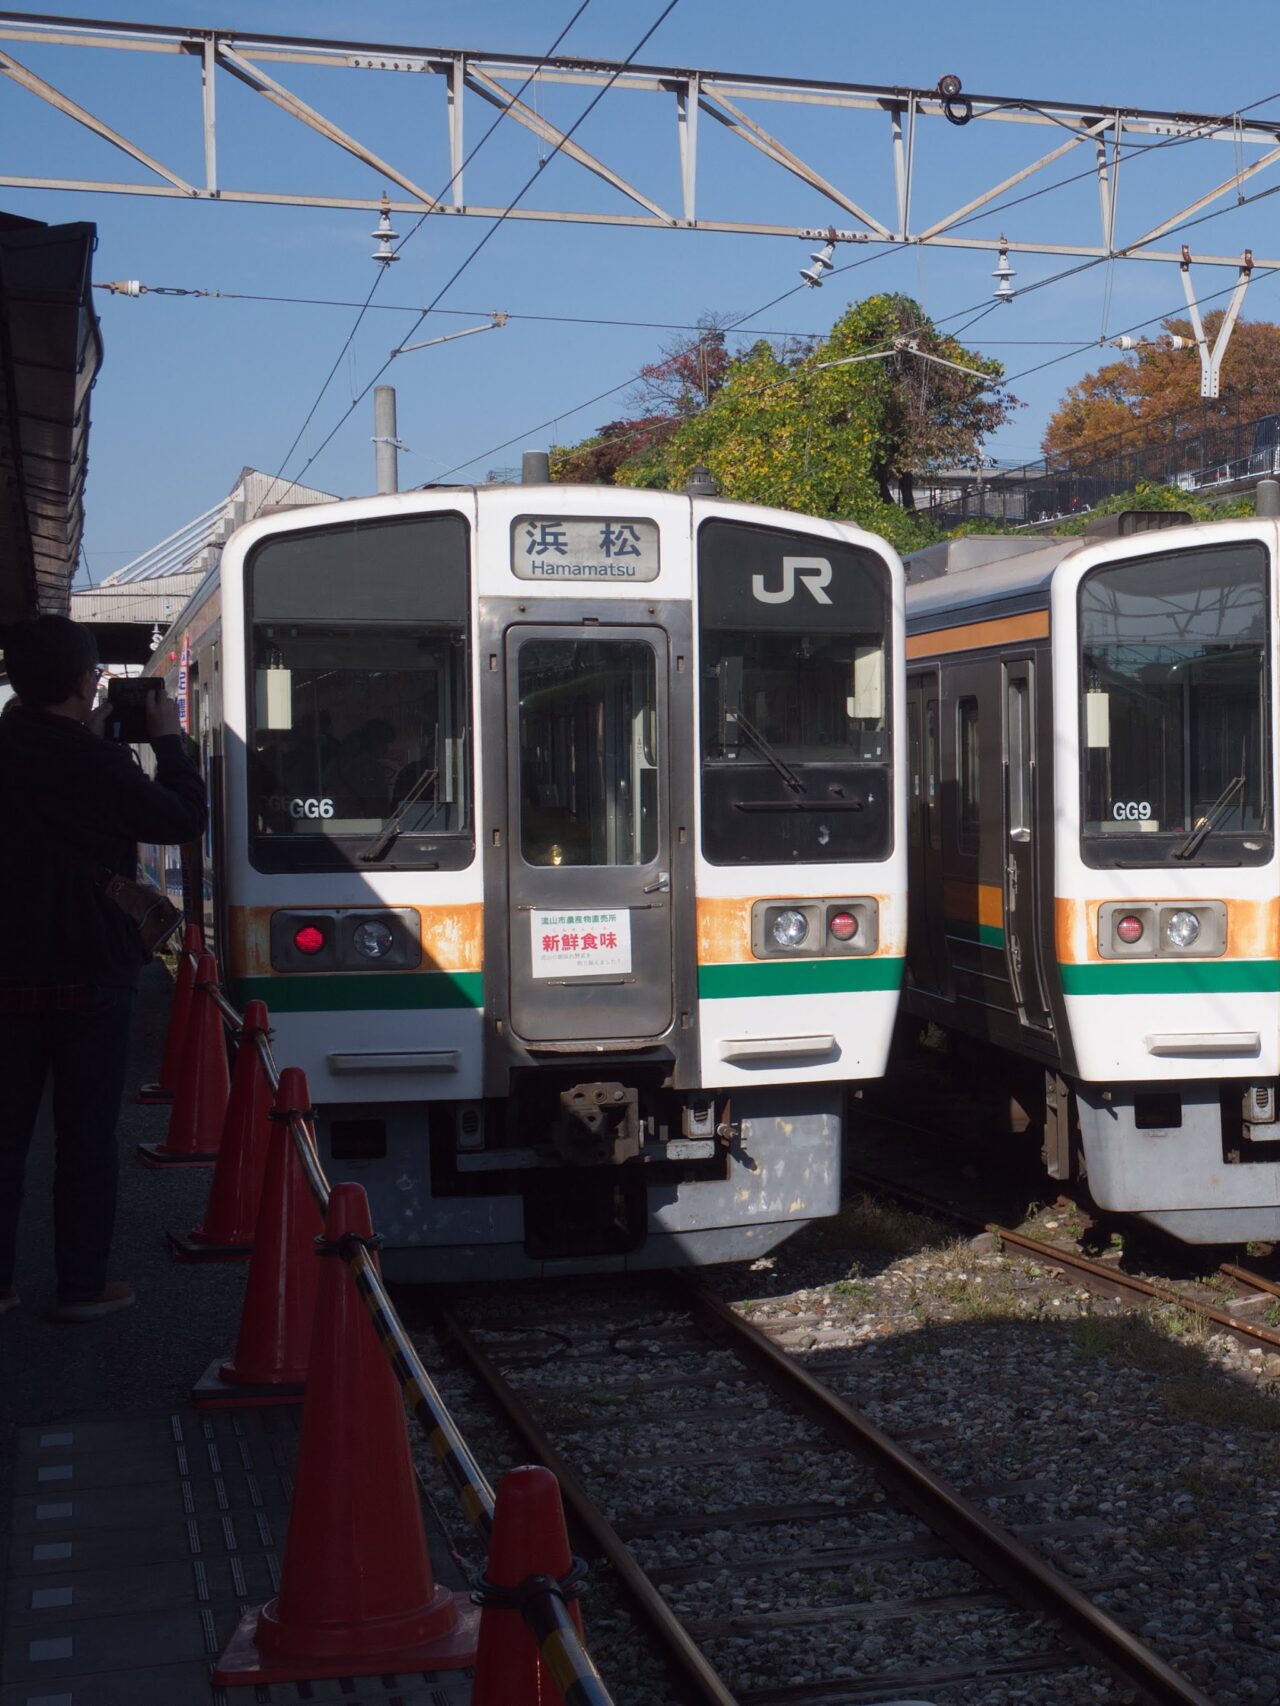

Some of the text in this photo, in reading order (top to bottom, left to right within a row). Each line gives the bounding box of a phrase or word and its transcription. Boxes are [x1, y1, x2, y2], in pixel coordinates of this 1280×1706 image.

[525, 520, 642, 558] 浜松
[531, 560, 636, 577] Hamamatsu
[752, 556, 833, 604] JR
[289, 798, 334, 818] GG6
[1113, 801, 1151, 820] GG9
[542, 931, 617, 952] 新鮮食味
